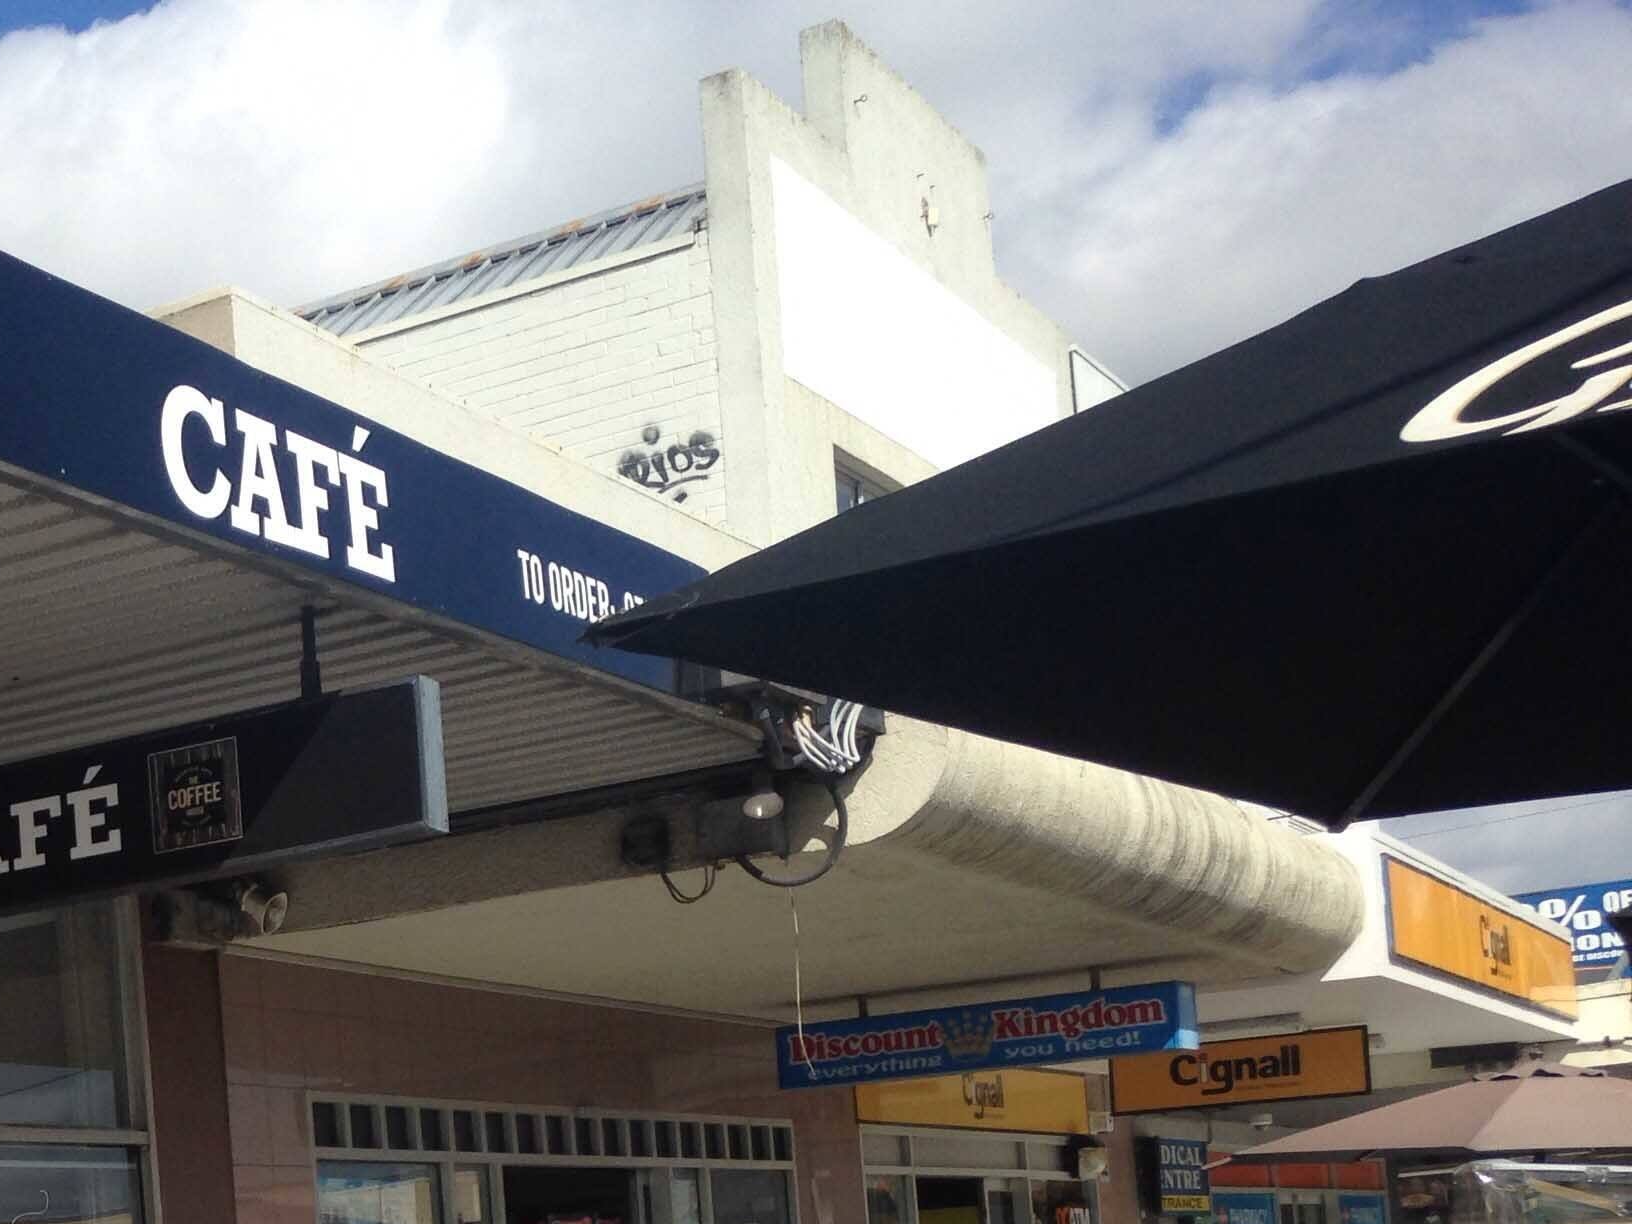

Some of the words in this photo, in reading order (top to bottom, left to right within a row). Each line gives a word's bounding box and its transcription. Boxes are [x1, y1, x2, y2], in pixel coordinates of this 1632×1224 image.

[160, 384, 396, 583] CAFÉ
[516, 549, 545, 604] TO
[168, 781, 222, 811] COFFEE
[788, 1020, 942, 1063] Discount
[992, 997, 1165, 1042] Kingdom
[808, 1055, 943, 1081] everything
[1004, 1040, 1056, 1060] you
[1064, 1031, 1141, 1052] need!
[1170, 1045, 1302, 1095] Cignall
